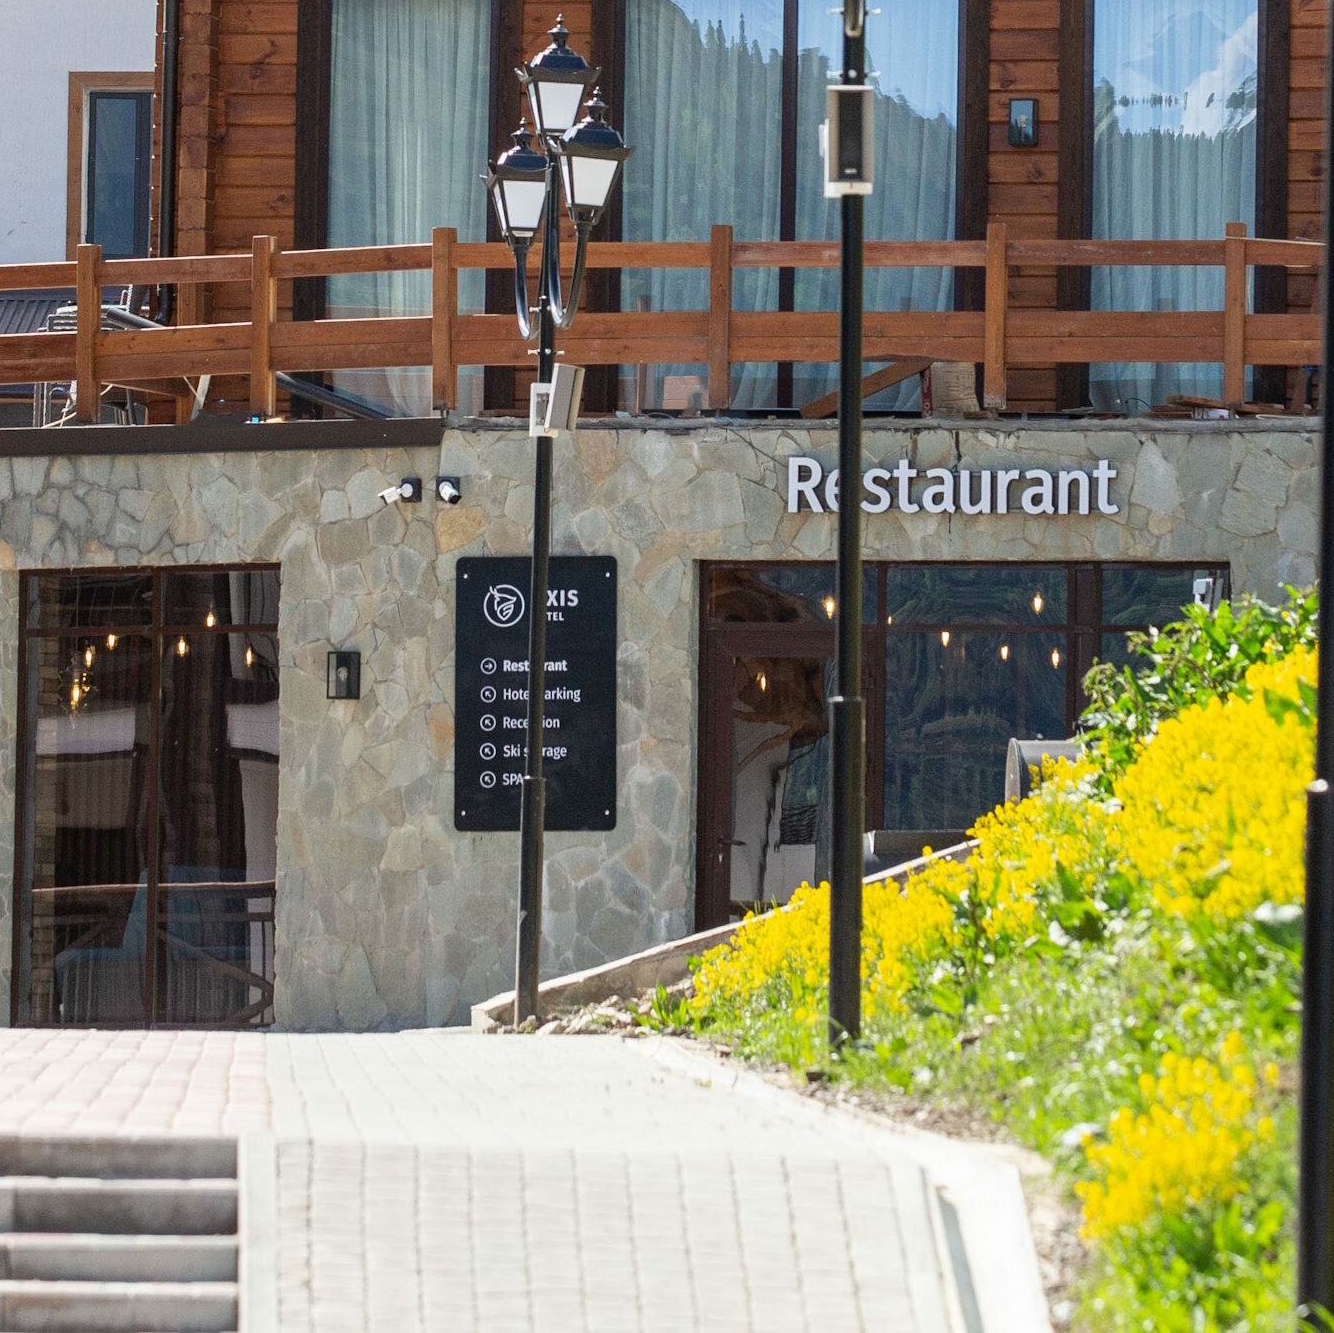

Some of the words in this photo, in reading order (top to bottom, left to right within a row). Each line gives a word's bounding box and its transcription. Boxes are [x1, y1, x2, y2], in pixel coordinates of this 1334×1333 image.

[546, 589, 579, 607] XIS
[503, 659, 568, 672] Restrant
[503, 687, 530, 701] Hote
[544, 686, 582, 703] arking
[503, 715, 560, 729] Receion
[503, 744, 521, 758] Ski
[523, 746, 567, 760] srage
[502, 772, 524, 786] SPA
